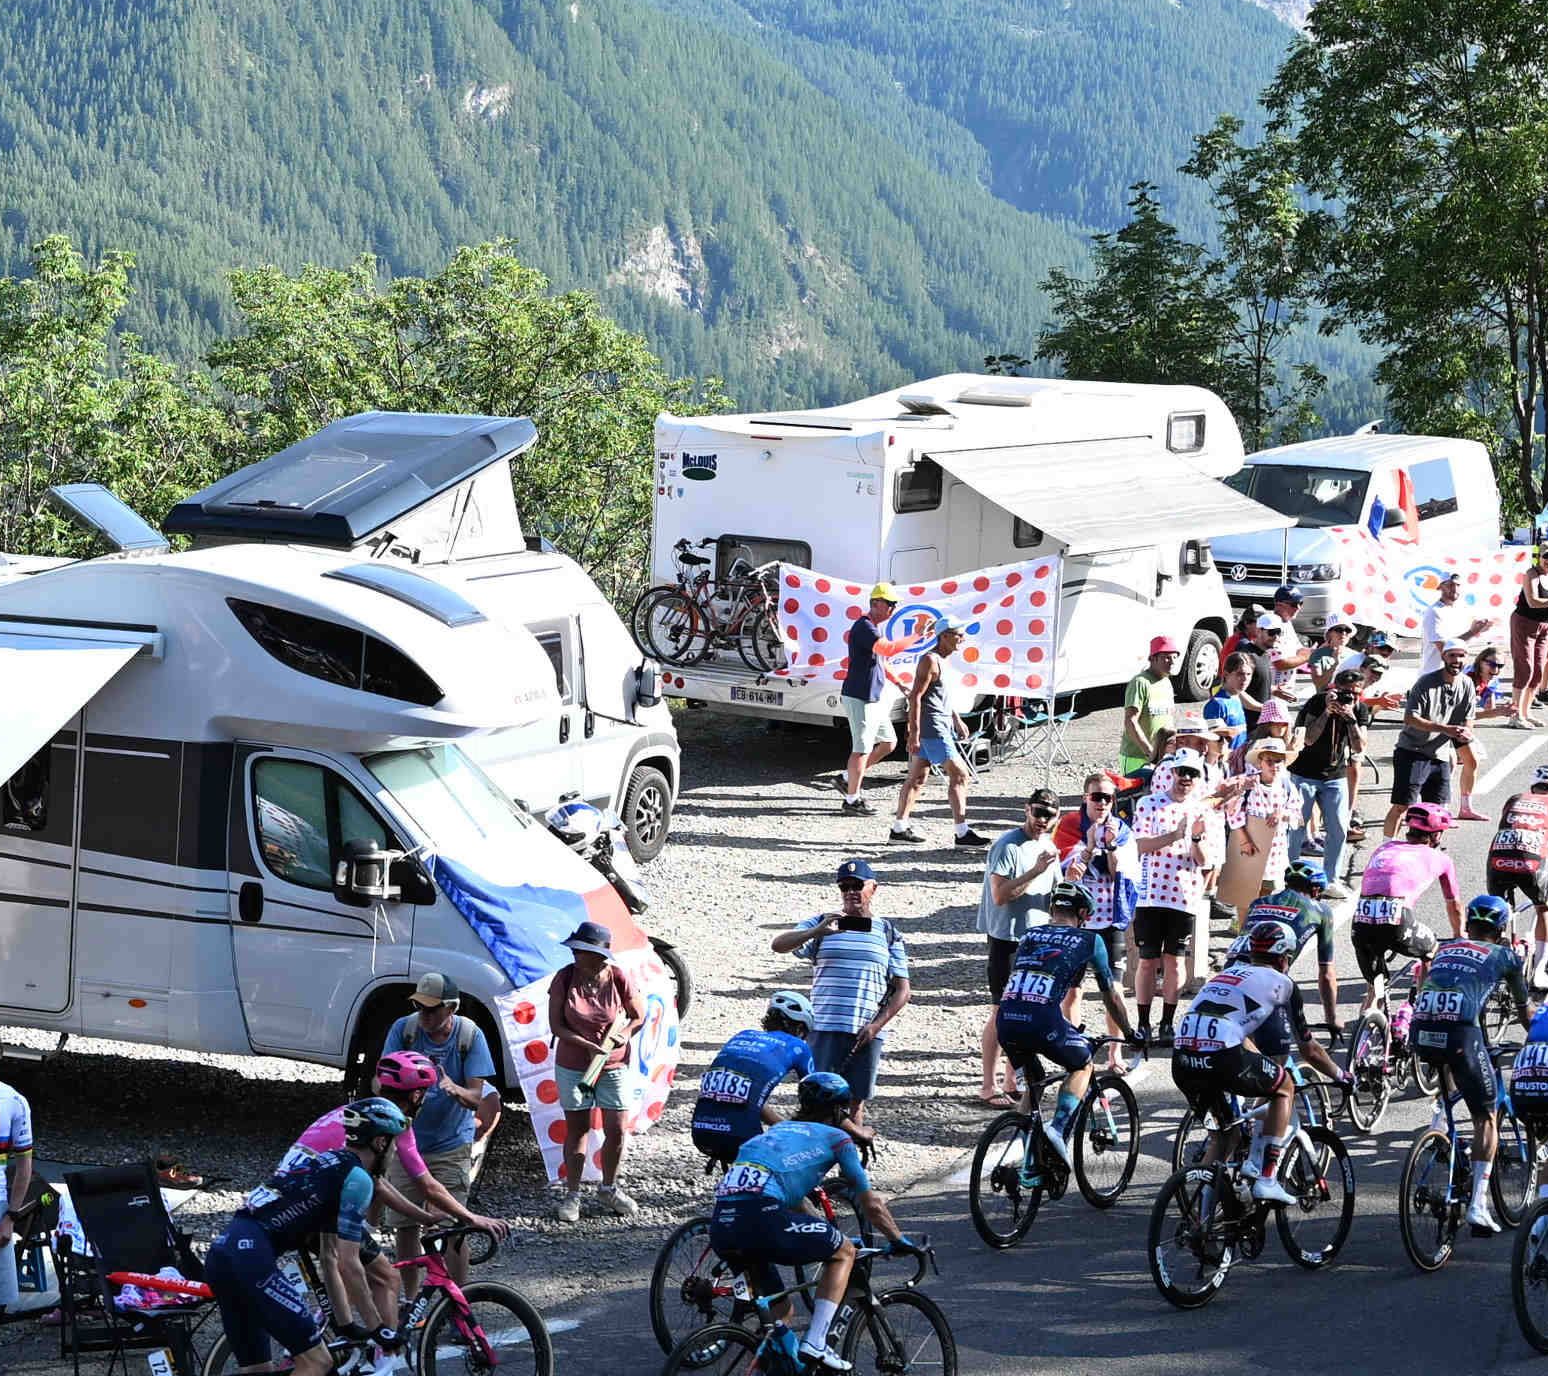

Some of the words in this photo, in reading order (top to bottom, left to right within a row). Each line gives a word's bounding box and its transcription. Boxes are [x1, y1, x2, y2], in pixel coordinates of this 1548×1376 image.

[1030, 974, 1047, 995] 75
[1437, 991, 1459, 1012] 95
[1180, 1017, 1190, 1036] 6
[1207, 1018, 1218, 1039] 6
[1190, 1056, 1214, 1070] IHC
[720, 1070, 749, 1097] 185
[782, 1148, 825, 1168] ASTANA
[738, 1166, 761, 1187] 63
[270, 1193, 322, 1231] OMNIYAT
